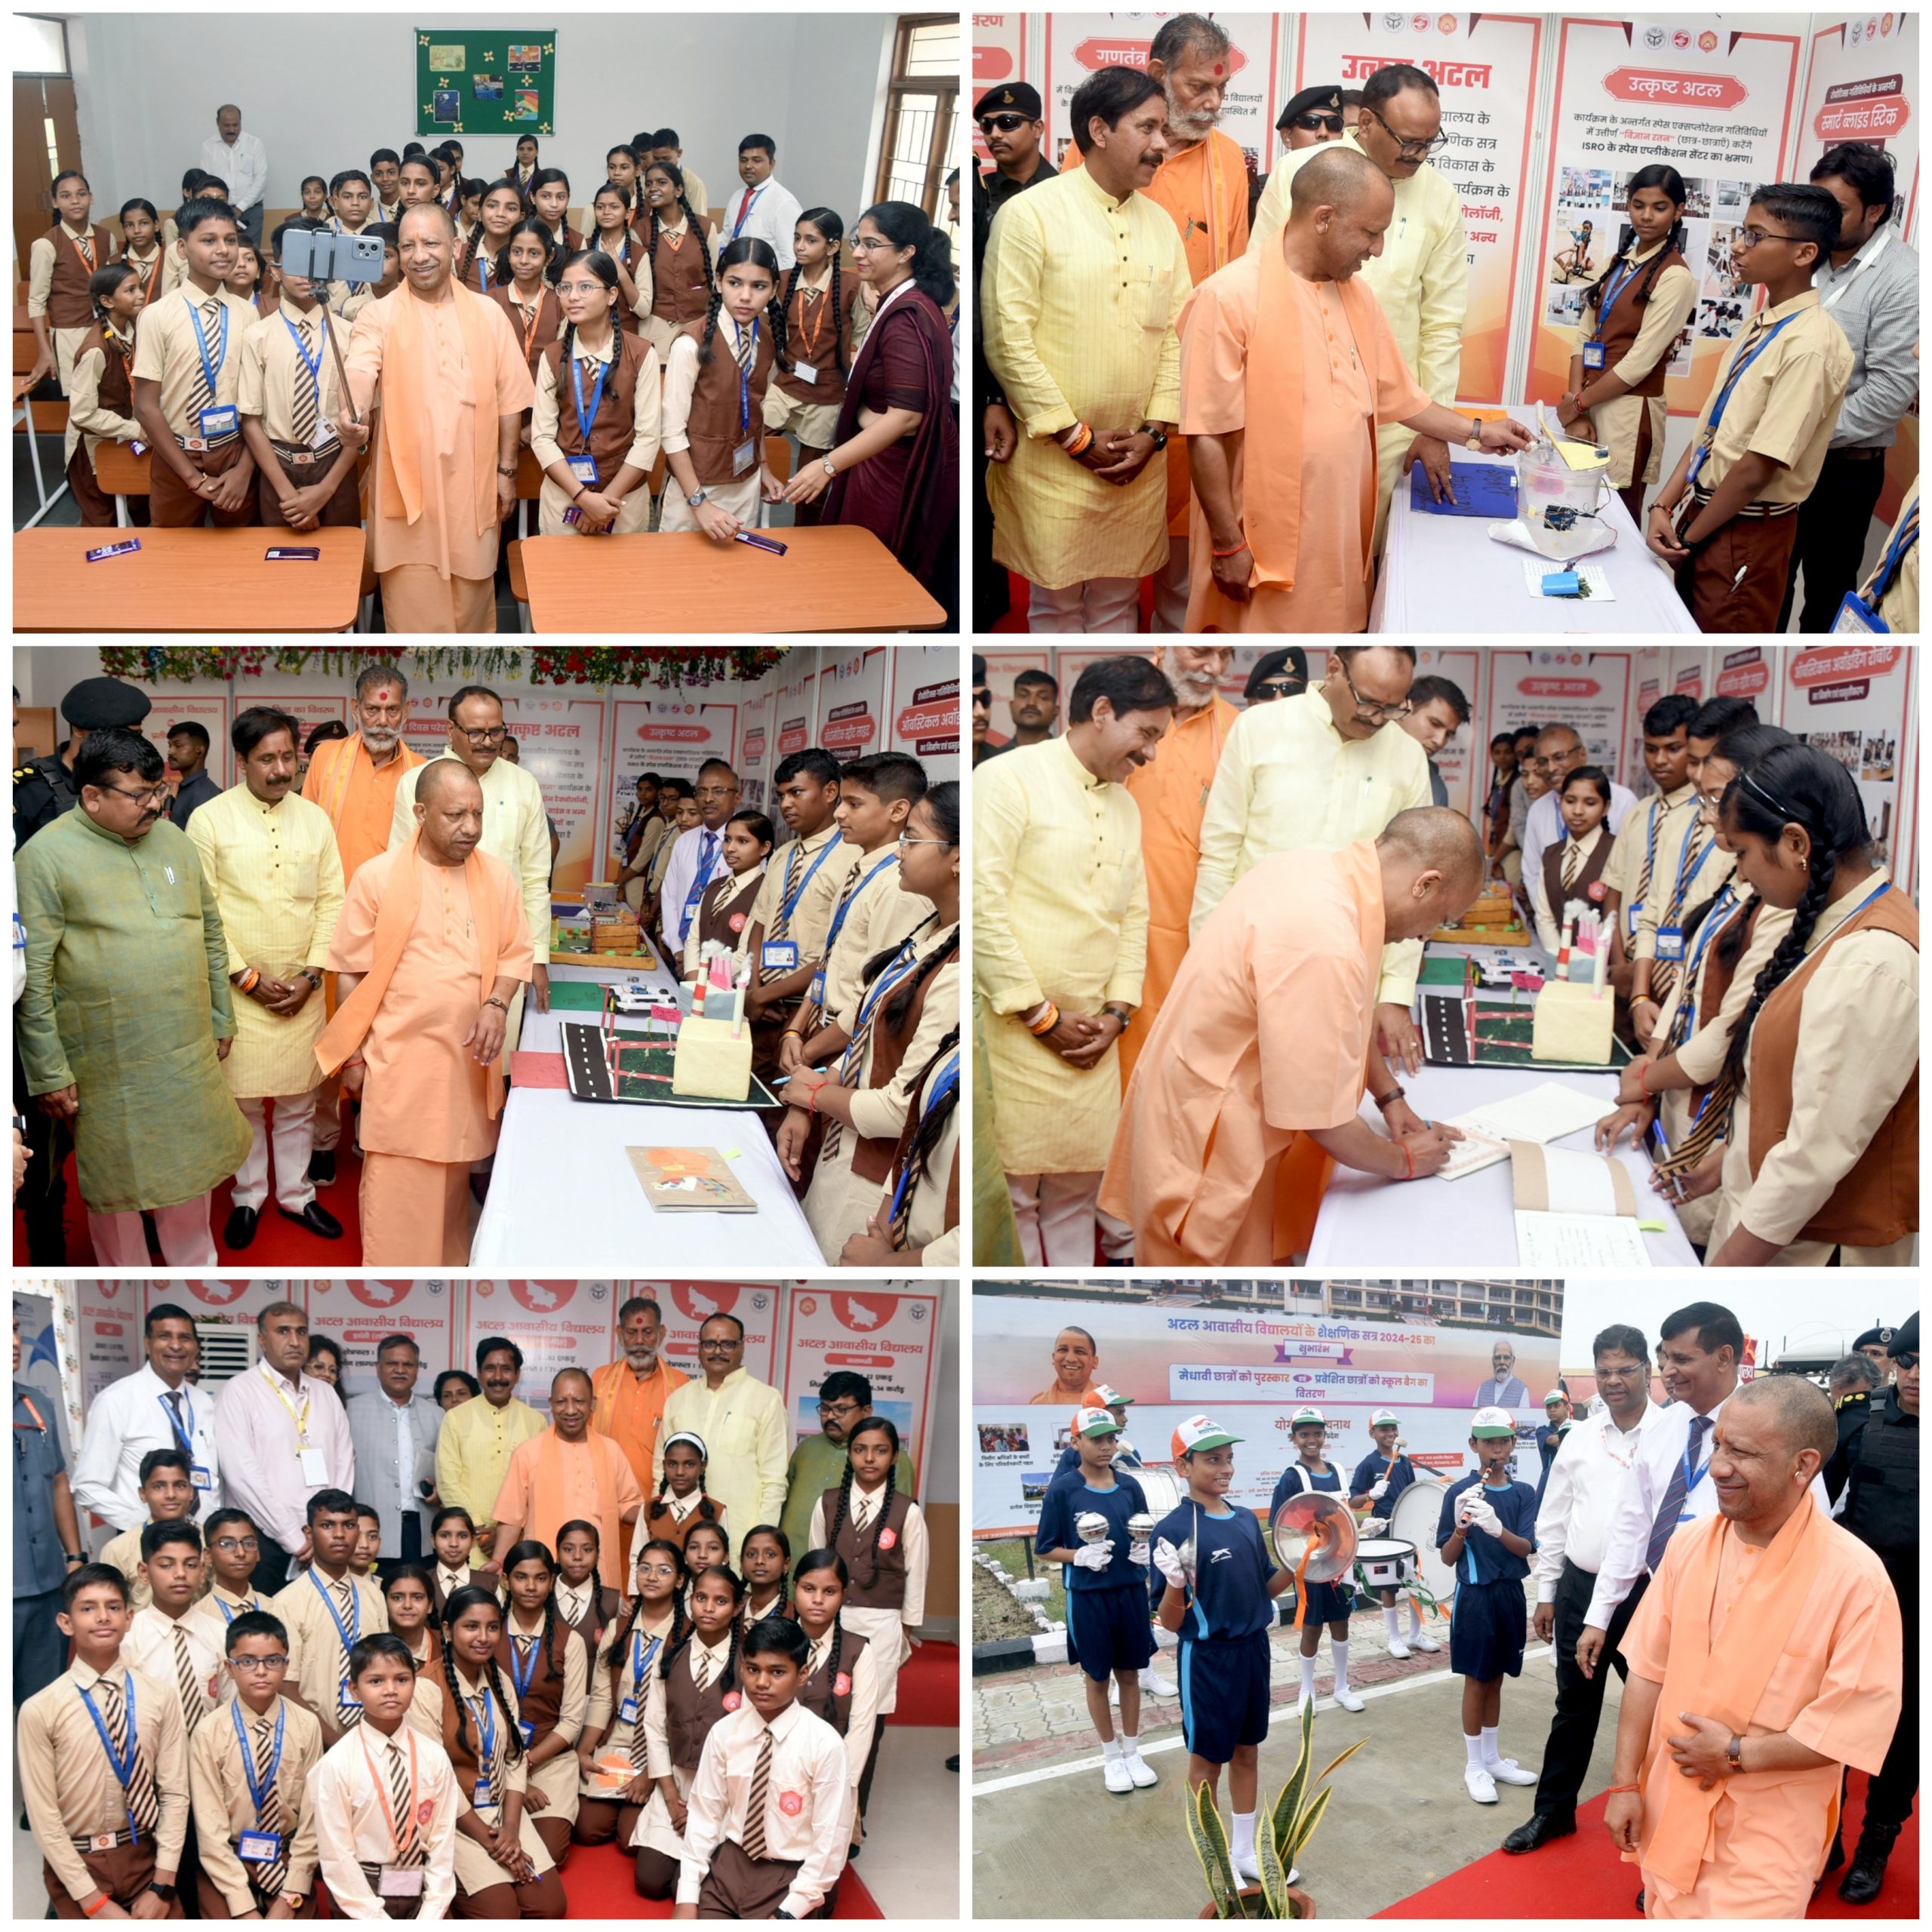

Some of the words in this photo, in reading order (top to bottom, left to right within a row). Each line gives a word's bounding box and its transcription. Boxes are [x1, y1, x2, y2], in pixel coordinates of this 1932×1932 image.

[1097, 47, 1147, 66] गणतंत्र
[1629, 76, 1679, 97] उत्कृष्ट
[1683, 82, 1723, 97] अटल
[1230, 92, 1263, 103] विद्यालयों
[1477, 111, 1491, 125] के
[1822, 109, 1844, 131] स्मार्ट
[1843, 107, 1870, 129] ब्लाइंड
[1870, 103, 1899, 128] स्टिक
[1574, 112, 1607, 125] कार्यक्रम
[1609, 115, 1618, 125] के
[1620, 117, 1651, 128] अन्तर्गत
[1653, 118, 1670, 129] स्पेस
[1672, 122, 1724, 134] एक्सप्लोरेशन
[1725, 125, 1767, 138] गतिविधियों
[1476, 137, 1497, 149] सत्र
[1586, 127, 1594, 137] में
[1595, 128, 1618, 138] उत्तीर्ण
[1732, 138, 1752, 150] करेंगे
[1582, 142, 1605, 152] ISRO
[1607, 142, 1617, 152] के
[1619, 143, 1638, 154] स्पेस
[1640, 143, 1687, 158] एप्लीकेशन
[1689, 148, 1709, 160] सेंटर
[1710, 152, 1722, 162] का
[1438, 155, 1479, 171] विकास
[1481, 158, 1495, 172] के
[1497, 183, 1510, 197] के
[1470, 231, 1497, 243] अन्य
[545, 724, 580, 737] अटल
[314, 1317, 343, 1327] अटल
[346, 1315, 395, 1327] आवासीय
[399, 1315, 444, 1328] विद्यालय
[476, 1321, 505, 1331] अटल
[508, 1320, 558, 1332] आवासीय
[561, 1321, 606, 1334] विद्यालय
[1168, 1318, 1199, 1330] अटल
[1203, 1318, 1252, 1334] आवासीय
[1256, 1320, 1303, 1337] विद्यालयों
[1304, 1324, 1315, 1337] के
[1318, 1324, 1360, 1340] शैक्षणिक
[1362, 1331, 1378, 1341] सत्र
[1380, 1332, 1422, 1344] 2024-25
[1423, 1335, 1435, 1345] का
[798, 1339, 827, 1349] अटल
[829, 1339, 877, 1352] आवासीय
[881, 1340, 923, 1354] विद्यालय
[1299, 1343, 1330, 1355] शुभारंभ
[1179, 1367, 1211, 1381] मेधावी
[1214, 1370, 1238, 1382] छात्रों
[1238, 1370, 1252, 1382] को
[1254, 1373, 1290, 1386] पुरस्कार
[1315, 1372, 1345, 1385] प्रवेशित
[1346, 1374, 1368, 1385] छात्रों
[1368, 1374, 1380, 1386] को
[1381, 1376, 1402, 1389] स्कूल
[1404, 1374, 1416, 1386] बैग
[1417, 1378, 1428, 1387] का
[1296, 1386, 1325, 1398] वितरण
